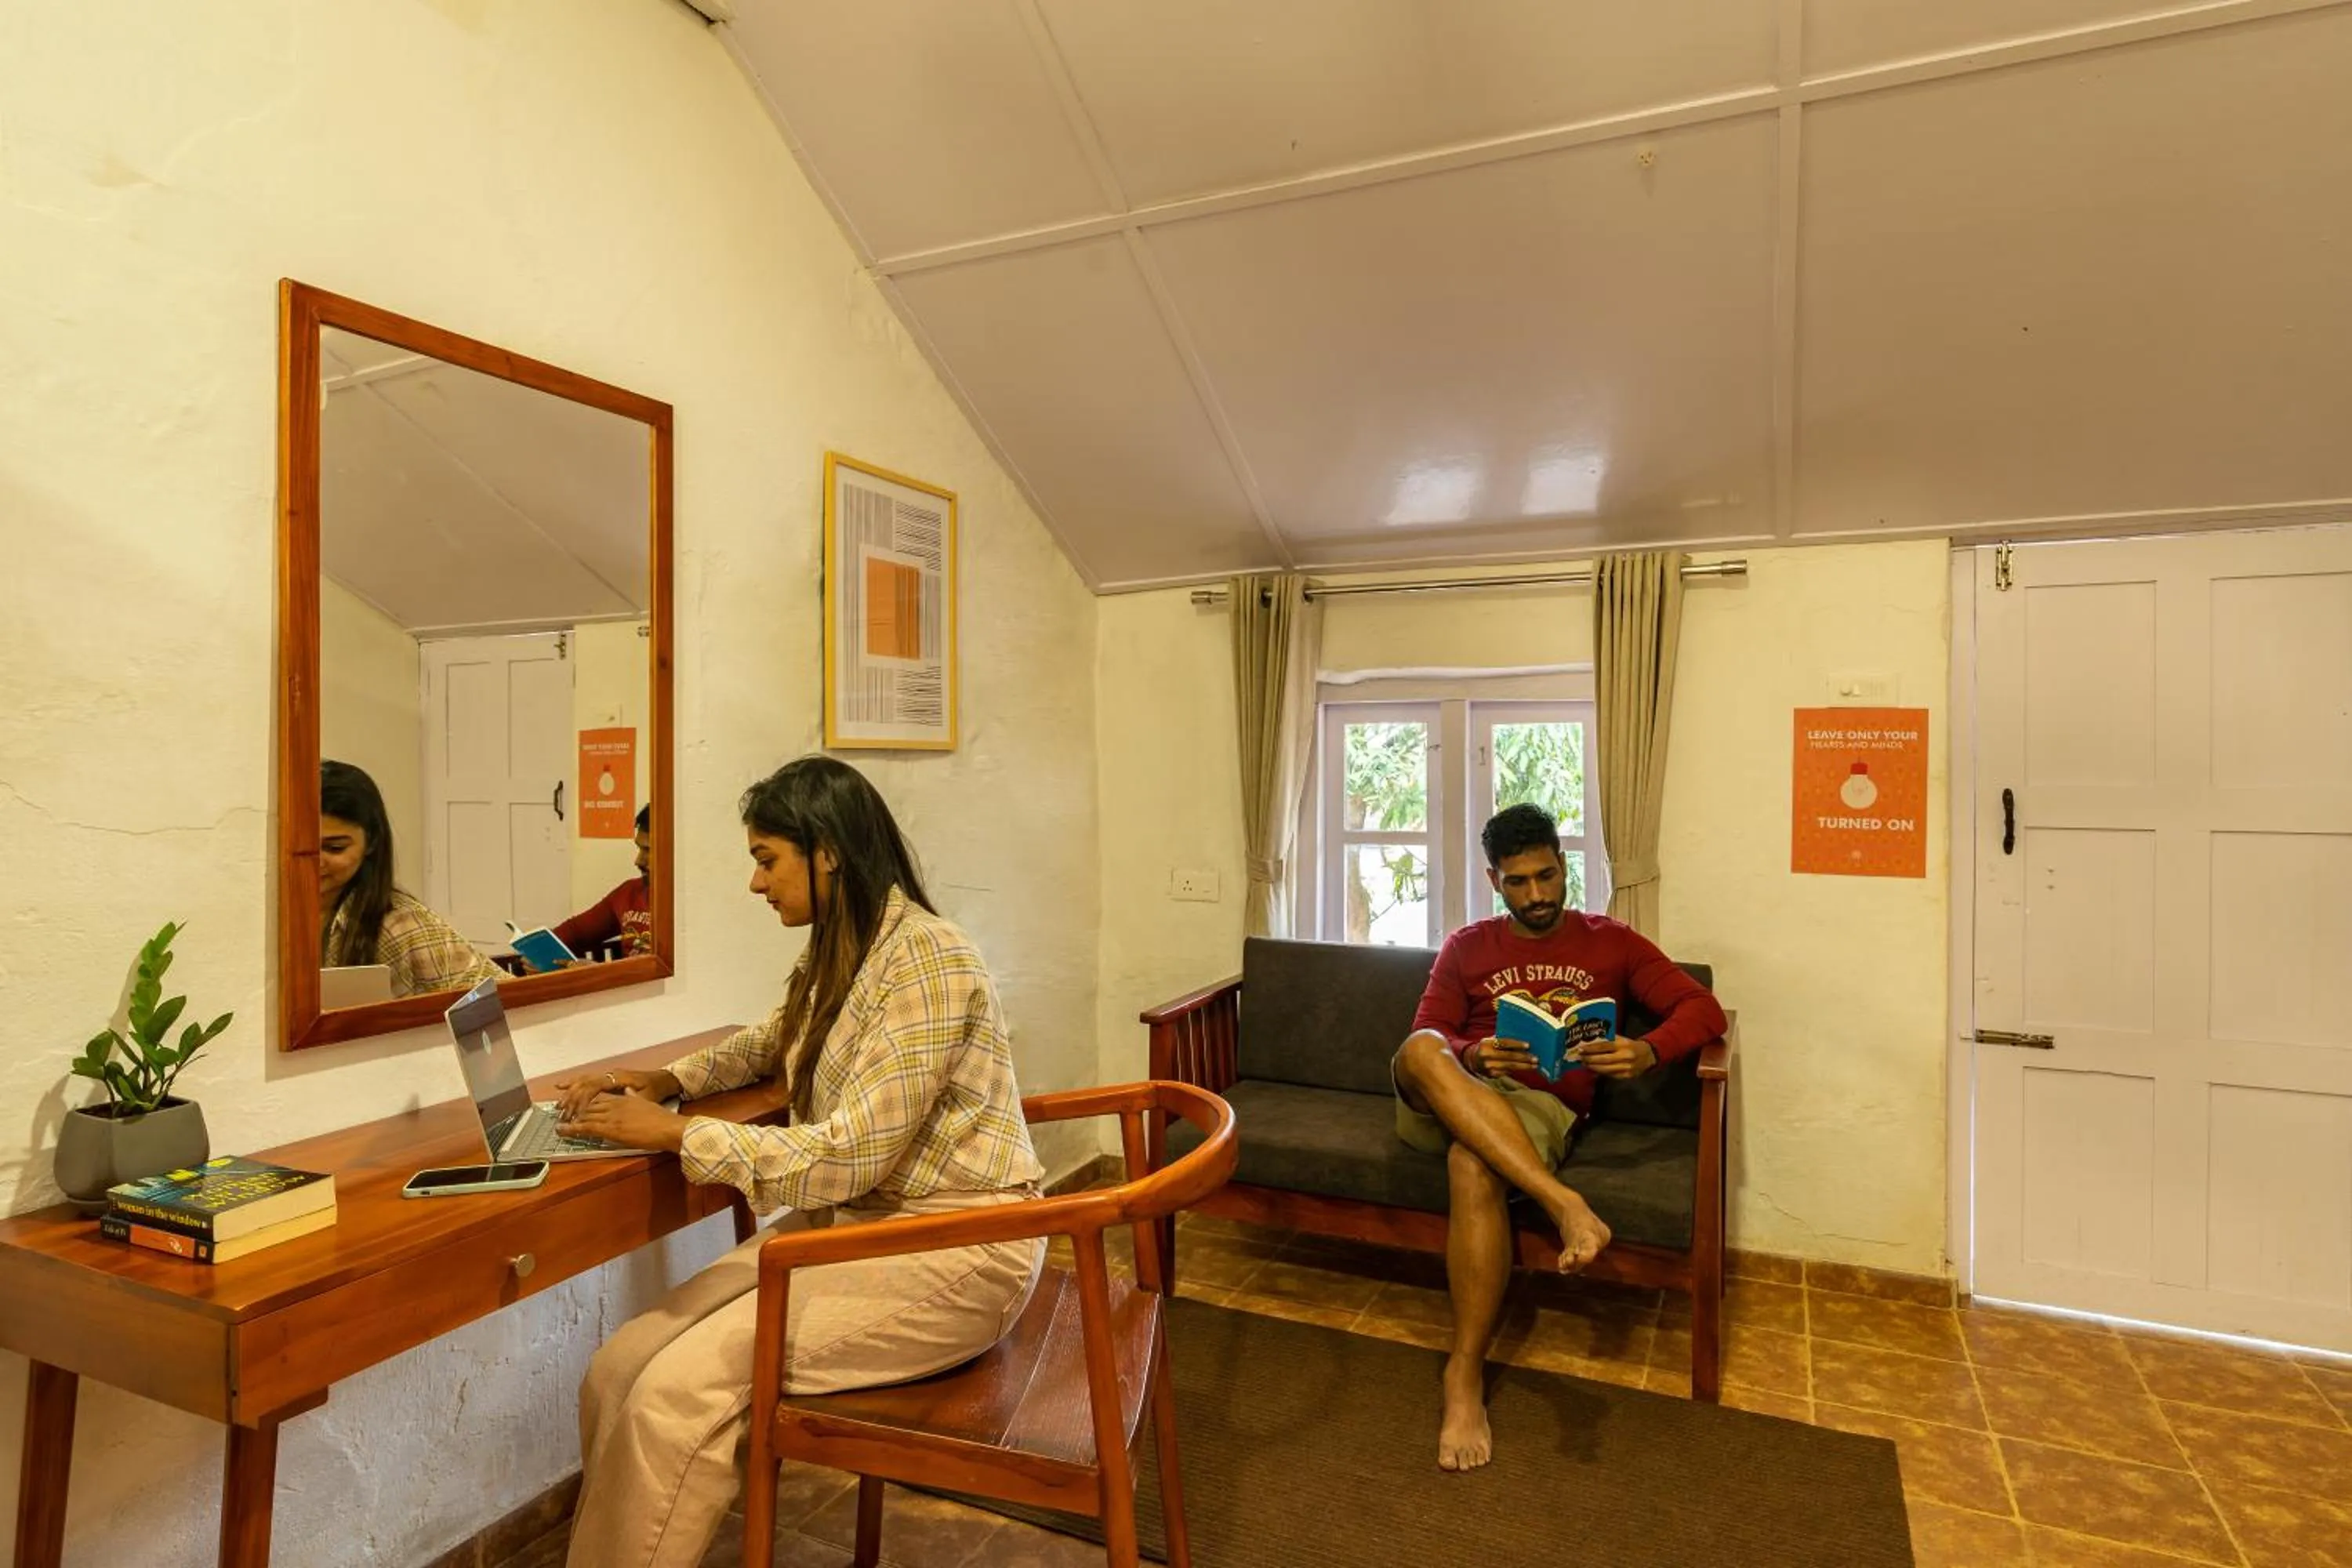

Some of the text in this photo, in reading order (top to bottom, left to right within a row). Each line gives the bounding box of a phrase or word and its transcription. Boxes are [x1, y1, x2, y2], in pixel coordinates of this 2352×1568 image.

[1807, 730, 1918, 741] LEAVE ONLY YOUR
[1817, 816, 1915, 831] TURNED ON
[1483, 964, 1594, 995] LEVI STRAUSS
